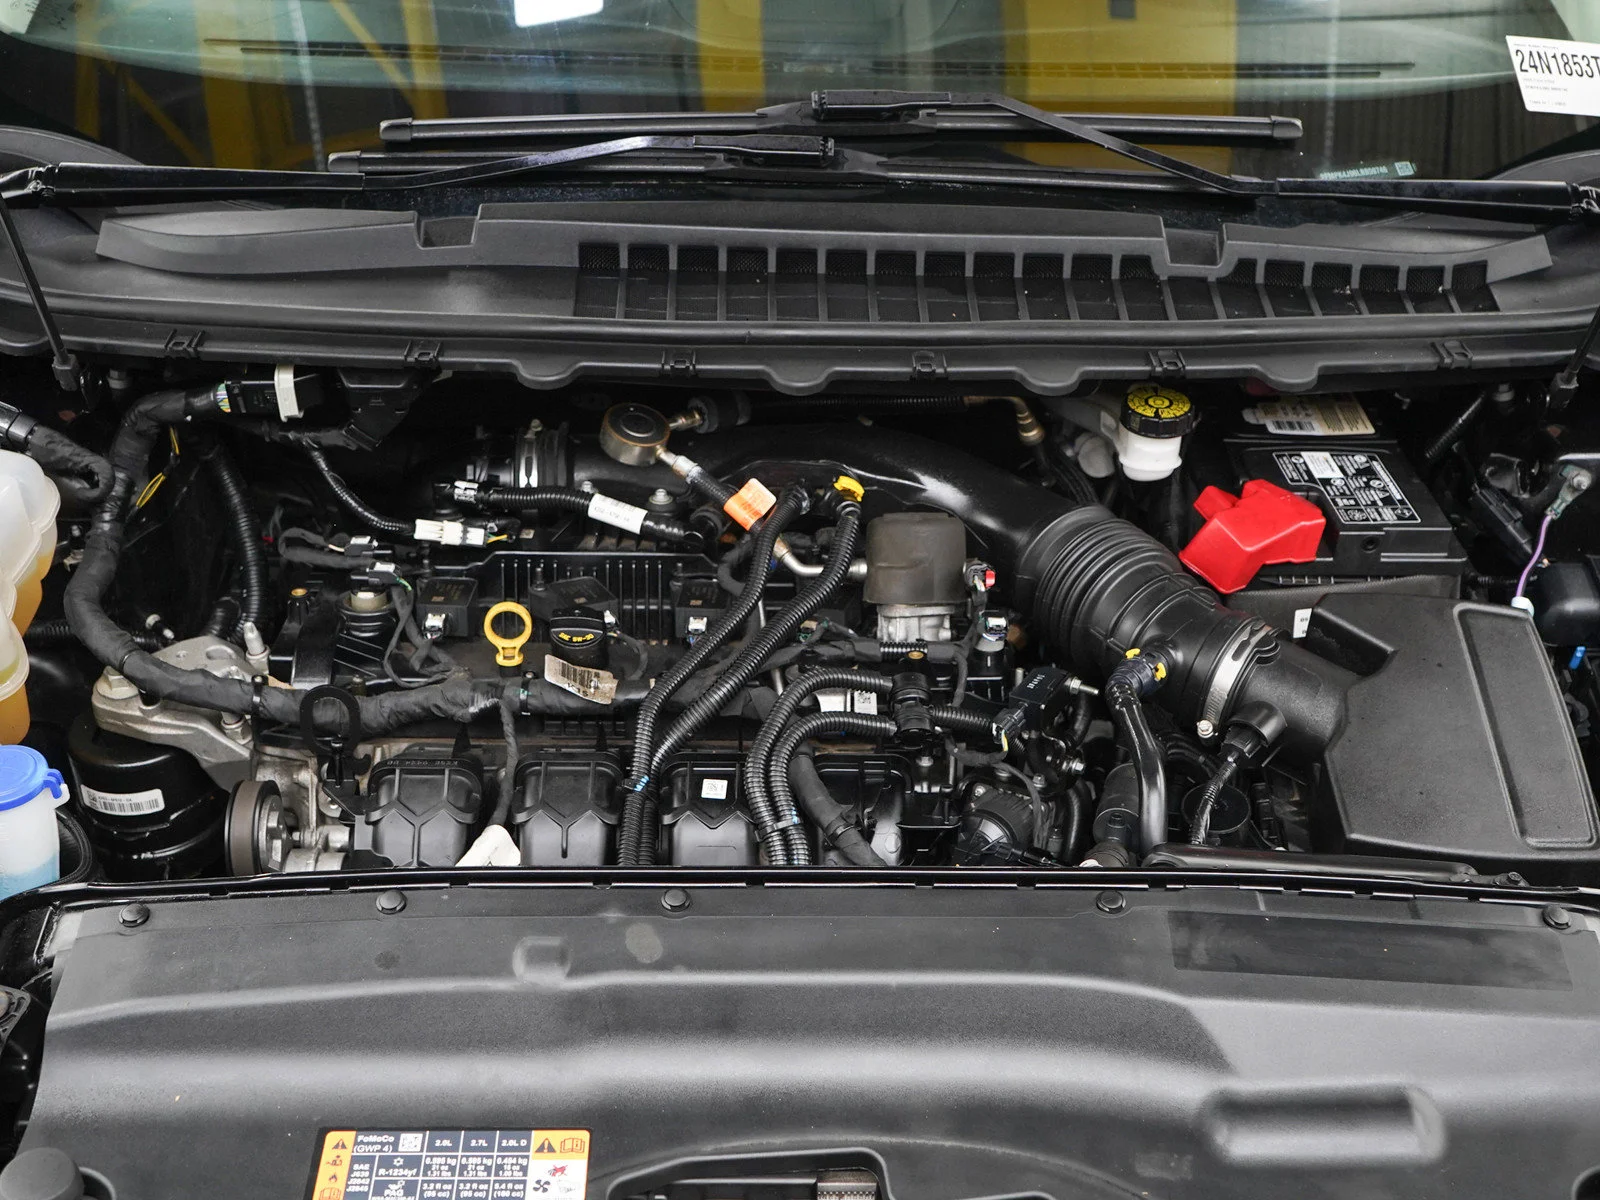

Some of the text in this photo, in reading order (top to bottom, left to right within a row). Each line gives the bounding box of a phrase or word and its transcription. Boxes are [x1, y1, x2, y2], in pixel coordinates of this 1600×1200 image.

[357, 1134, 395, 1143] FoMoCo
[470, 1139, 488, 1147] 2.7L
[520, 1139, 527, 1147] D
[353, 1145, 393, 1153] (GWP 4)
[446, 1157, 457, 1166] kg
[482, 1157, 493, 1166] kg
[518, 1157, 528, 1166] kg
[378, 1168, 417, 1178] R-1234yf
